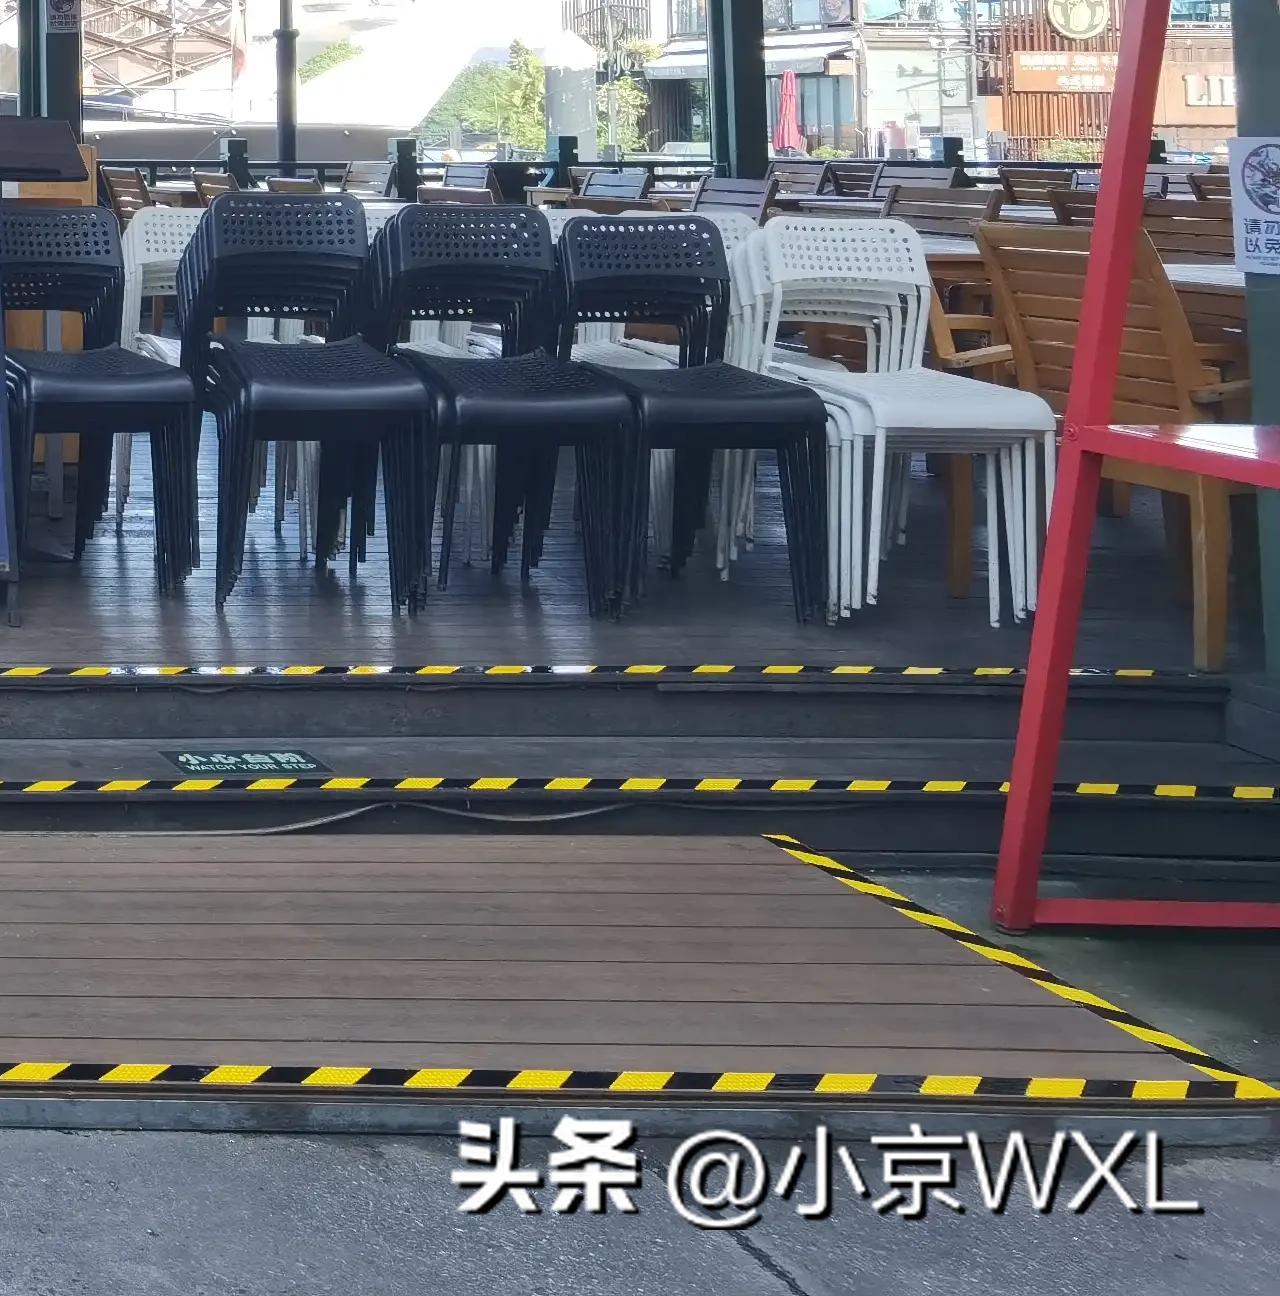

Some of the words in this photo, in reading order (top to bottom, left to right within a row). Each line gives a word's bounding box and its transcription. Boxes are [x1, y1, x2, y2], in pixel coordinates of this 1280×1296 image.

[178, 752, 307, 764] 小心台阶
[186, 763, 237, 772] WATCH
[240, 763, 279, 771] YOUR
[282, 762, 317, 770] STEP
